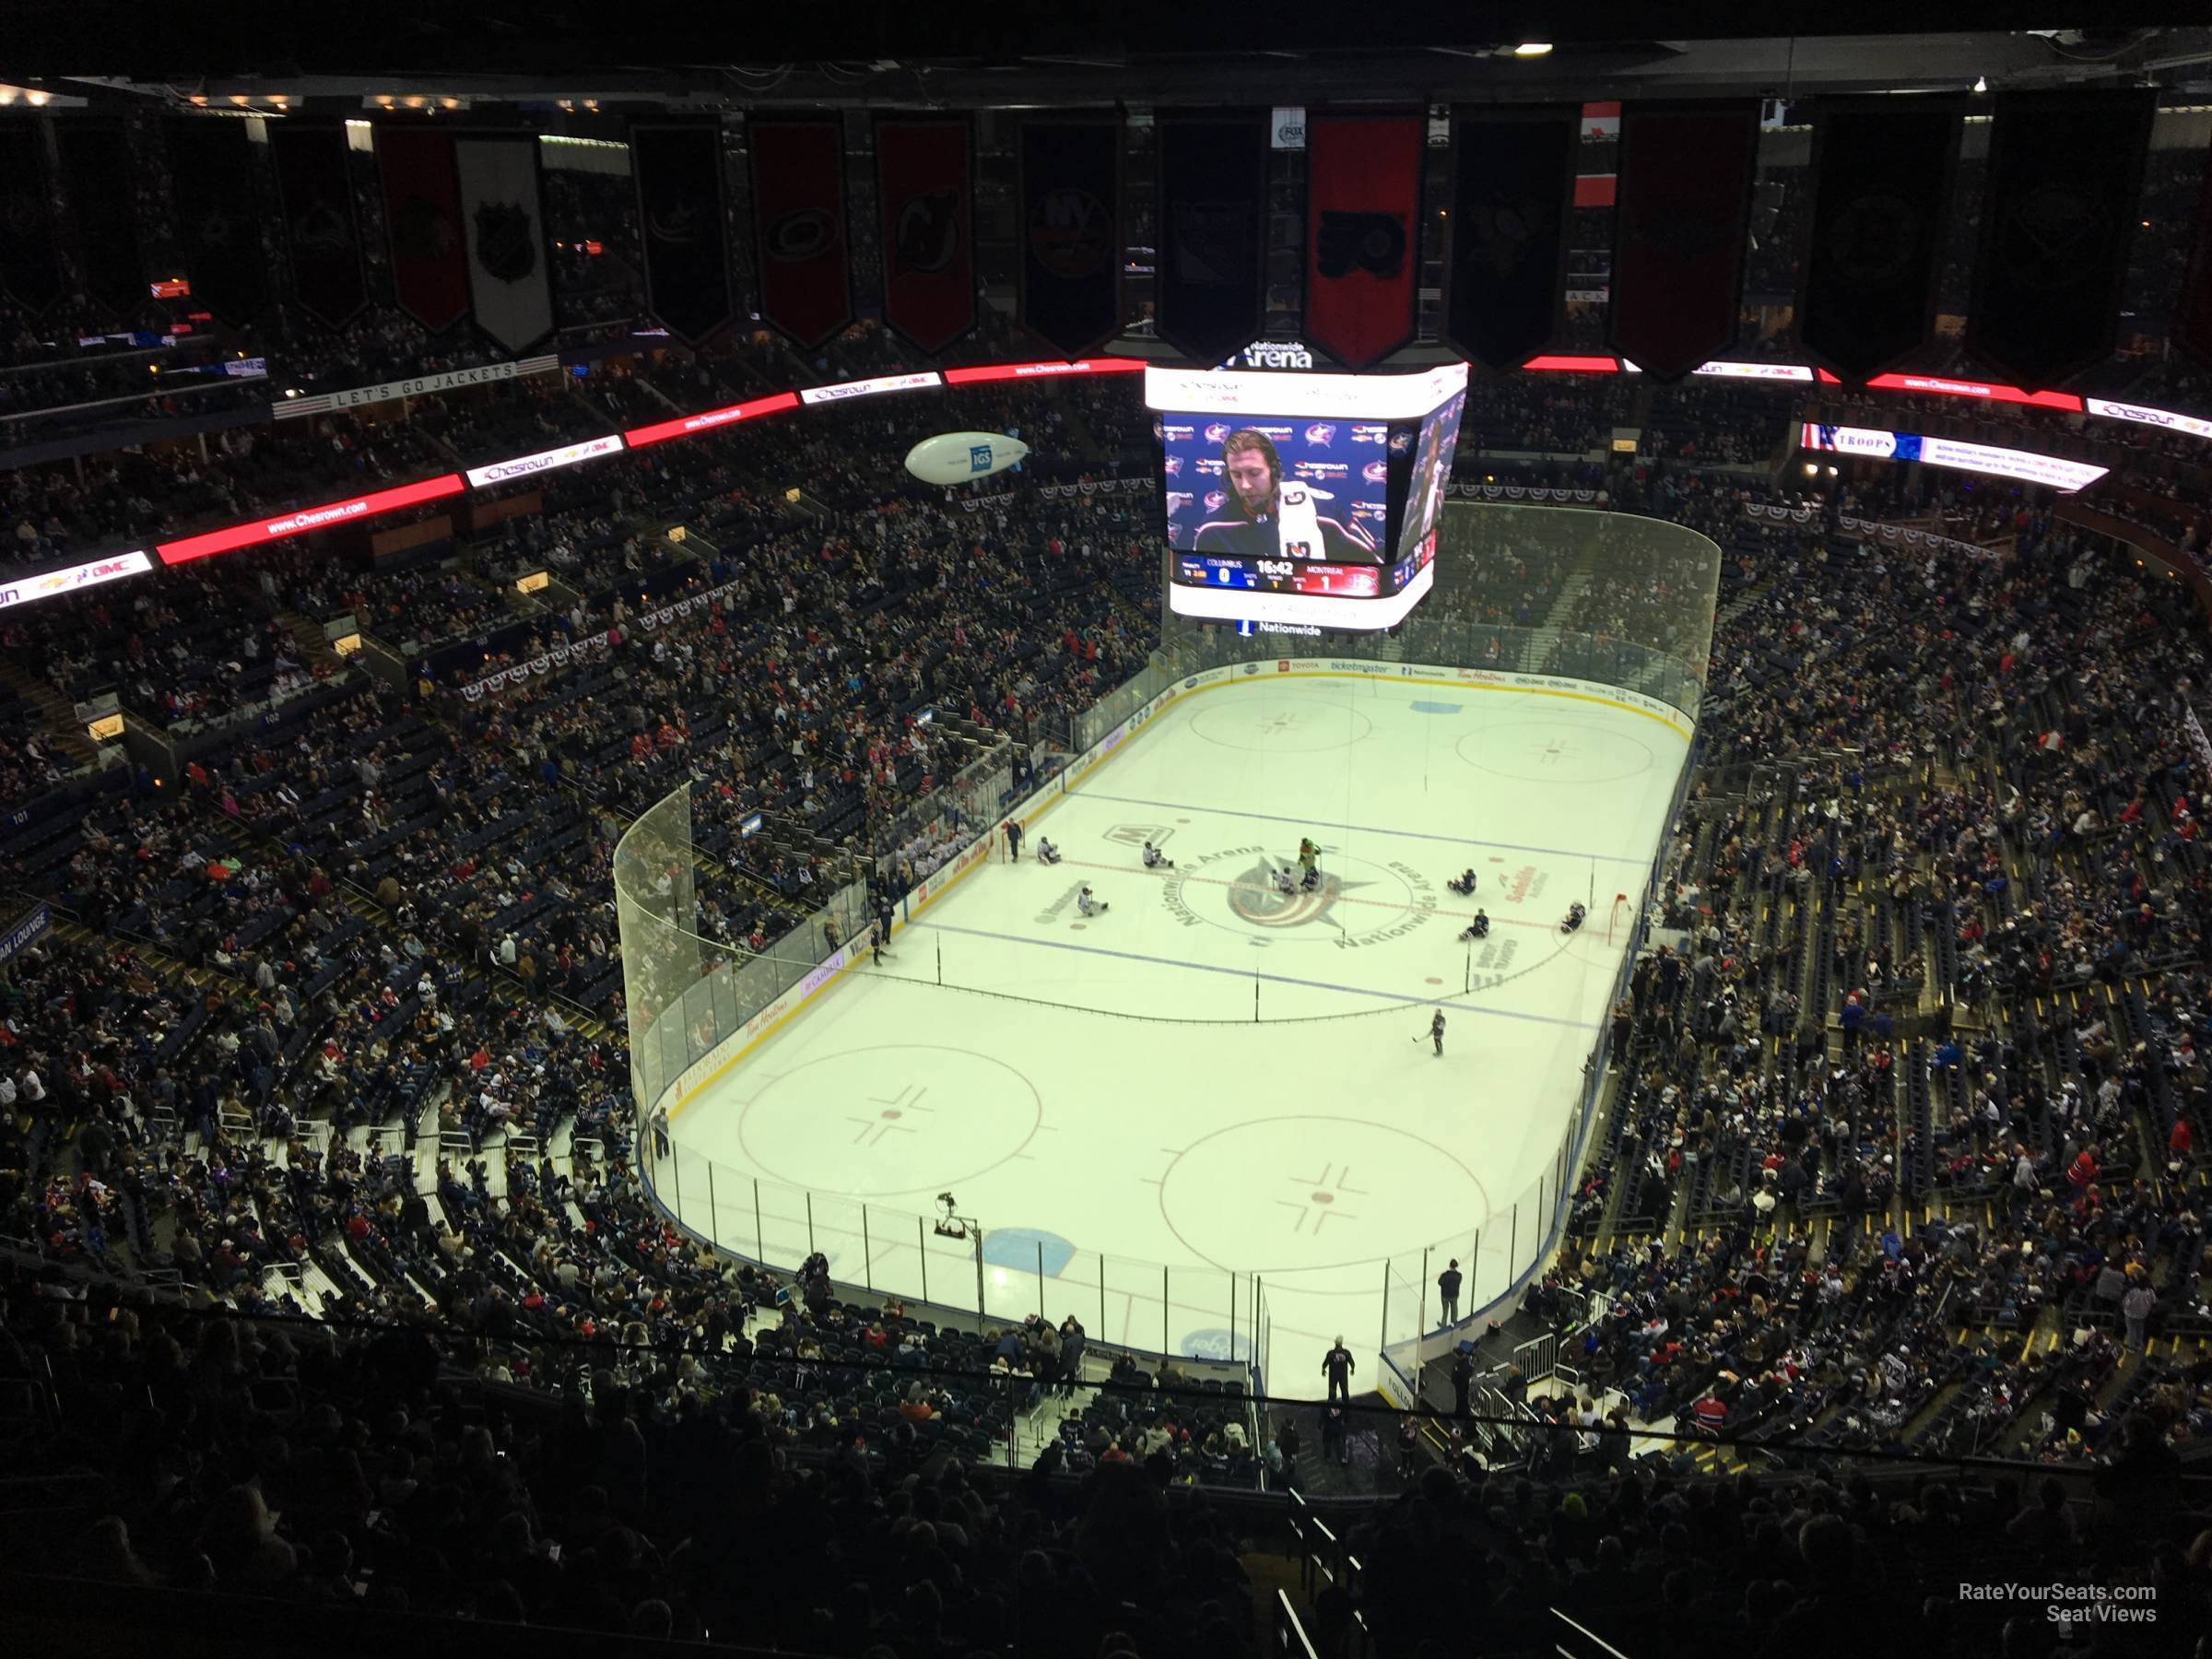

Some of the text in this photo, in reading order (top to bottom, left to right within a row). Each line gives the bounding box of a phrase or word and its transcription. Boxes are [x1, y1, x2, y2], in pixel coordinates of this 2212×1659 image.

[1250, 340, 1305, 351] Nationwide
[337, 364, 512, 406] LET'S GO JACKETS
[973, 451, 992, 465] IGS
[267, 501, 367, 534] www.Chesrown.com
[93, 559, 130, 577] GMC
[1206, 559, 1242, 569] COLUMBUS
[1257, 559, 1294, 576] 16:42
[1306, 565, 1343, 576] MONTREAL
[1219, 568, 1230, 583] 0
[1321, 576, 1330, 591] 1
[1259, 621, 1322, 637] Nationwide
[1331, 661, 1387, 674] ticketmaster
[13, 810, 28, 825] 101
[13, 911, 46, 948] LOUNGE
